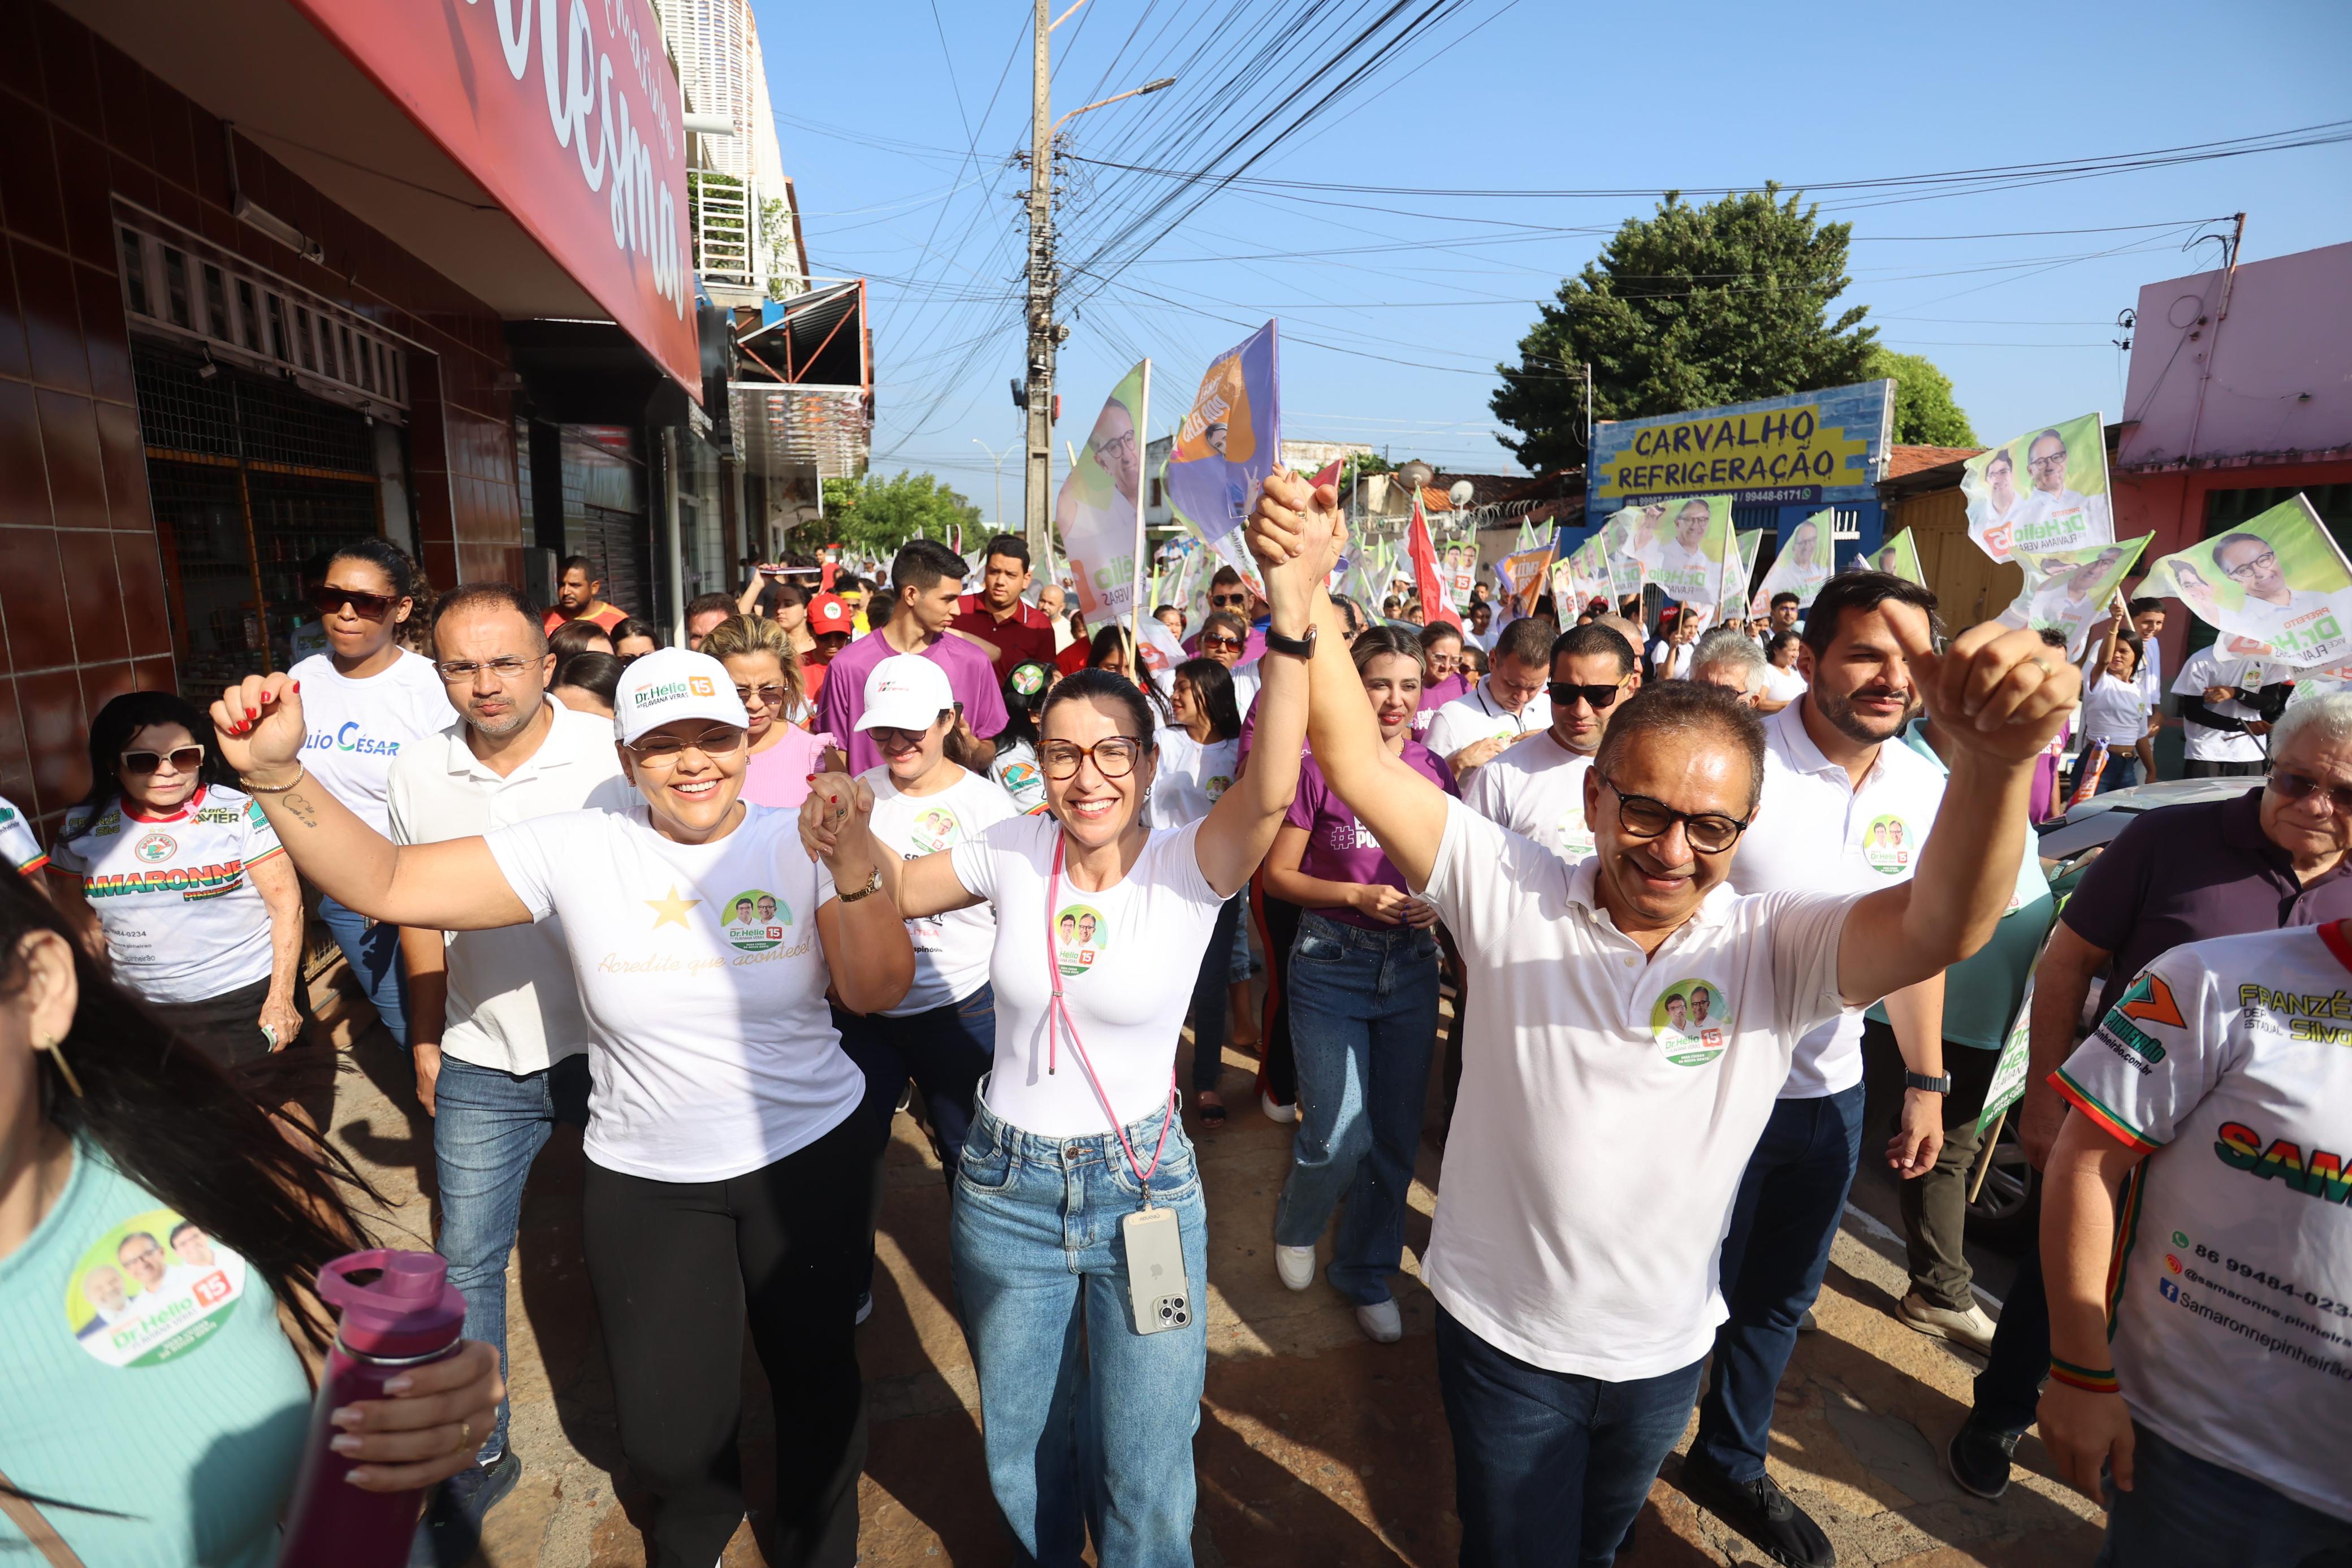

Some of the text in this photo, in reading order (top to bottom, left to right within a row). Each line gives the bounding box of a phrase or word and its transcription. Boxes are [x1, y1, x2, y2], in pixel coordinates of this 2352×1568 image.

[1635, 410, 1814, 457] CARVALHO
[1618, 443, 1834, 490] REFRIGERAÇÃO
[1745, 489, 1801, 503] 99448-6171
[670, 692, 689, 700] VERAS
[691, 679, 711, 694] 15
[337, 721, 400, 756] CÉSAR
[95, 825, 120, 837] Silva
[83, 859, 243, 898] AMARONNE
[768, 928, 780, 938] 15
[598, 936, 811, 977] Acredite que acontece!
[1080, 952, 1092, 963] 15
[2238, 984, 2352, 1019] FRANZÉ
[1704, 1031, 1720, 1045] 15
[2194, 1244, 2220, 1264] 86
[198, 1274, 228, 1301] 15
